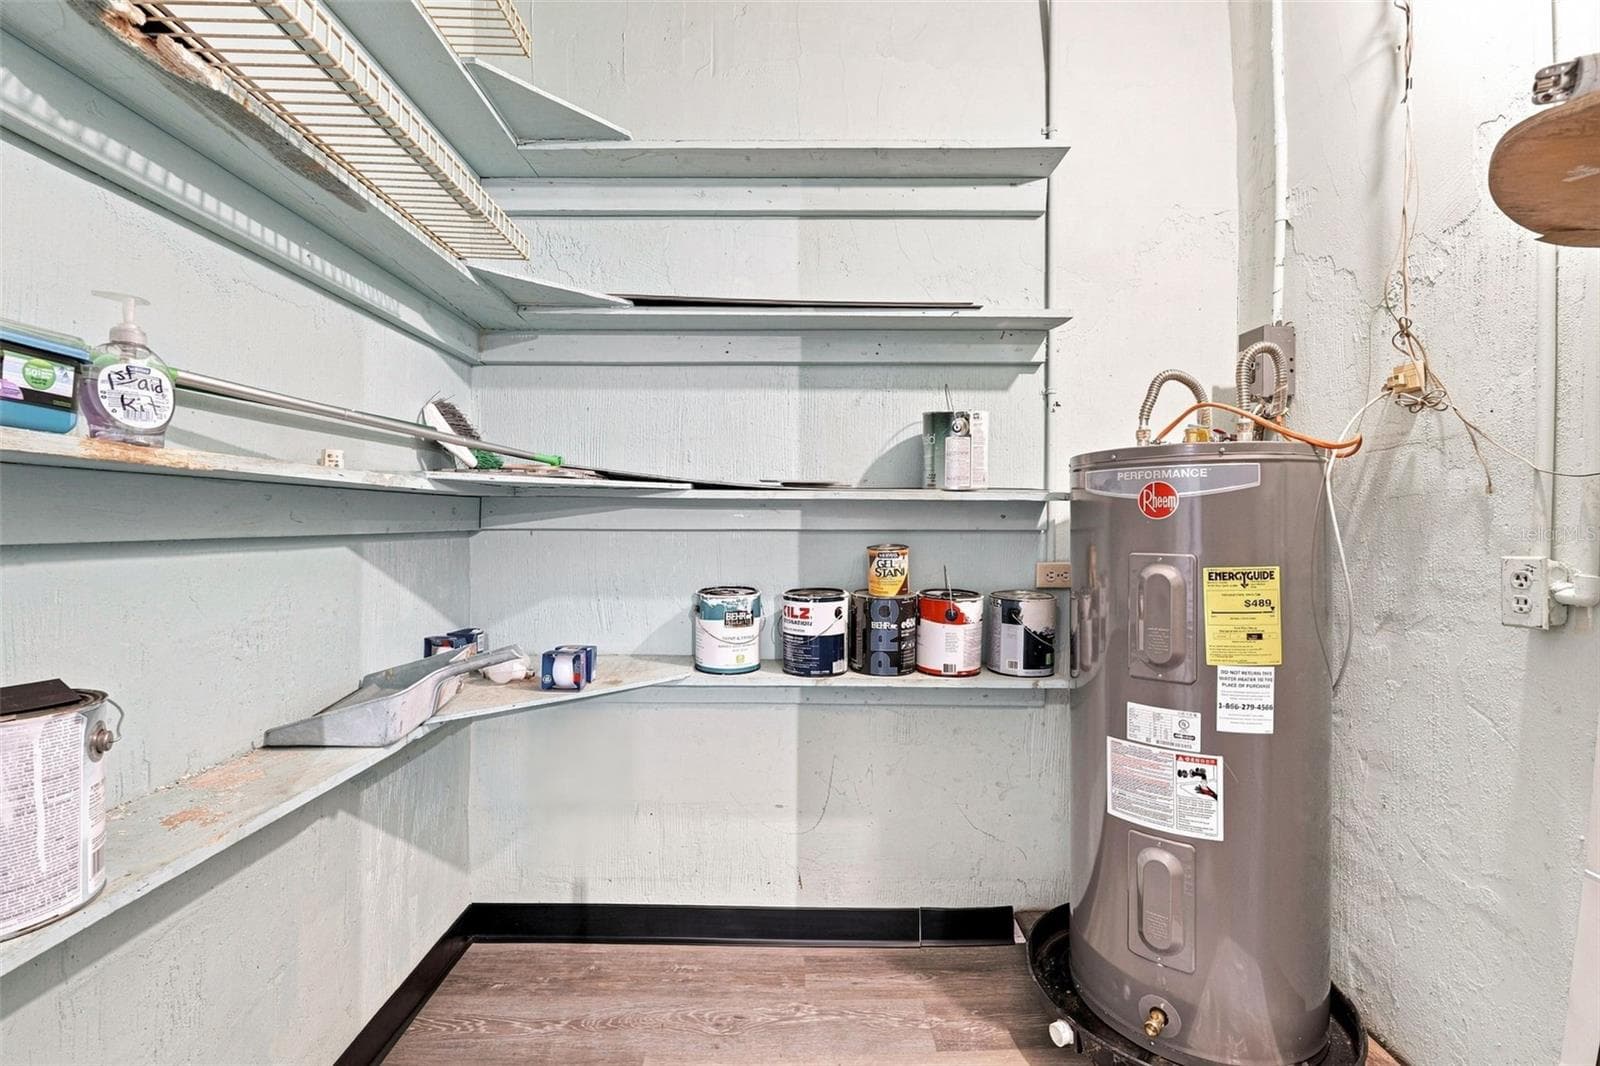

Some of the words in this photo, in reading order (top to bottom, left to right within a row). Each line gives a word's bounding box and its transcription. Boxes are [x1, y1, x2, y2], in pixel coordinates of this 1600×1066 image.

[137, 378, 163, 394] aid
[120, 394, 161, 416] Kit
[1117, 468, 1208, 481] PERFORMANCE
[1142, 482, 1177, 513] Rheem
[876, 559, 894, 568] GEL
[875, 567, 906, 578] STAIN
[871, 621, 891, 629] BEHR
